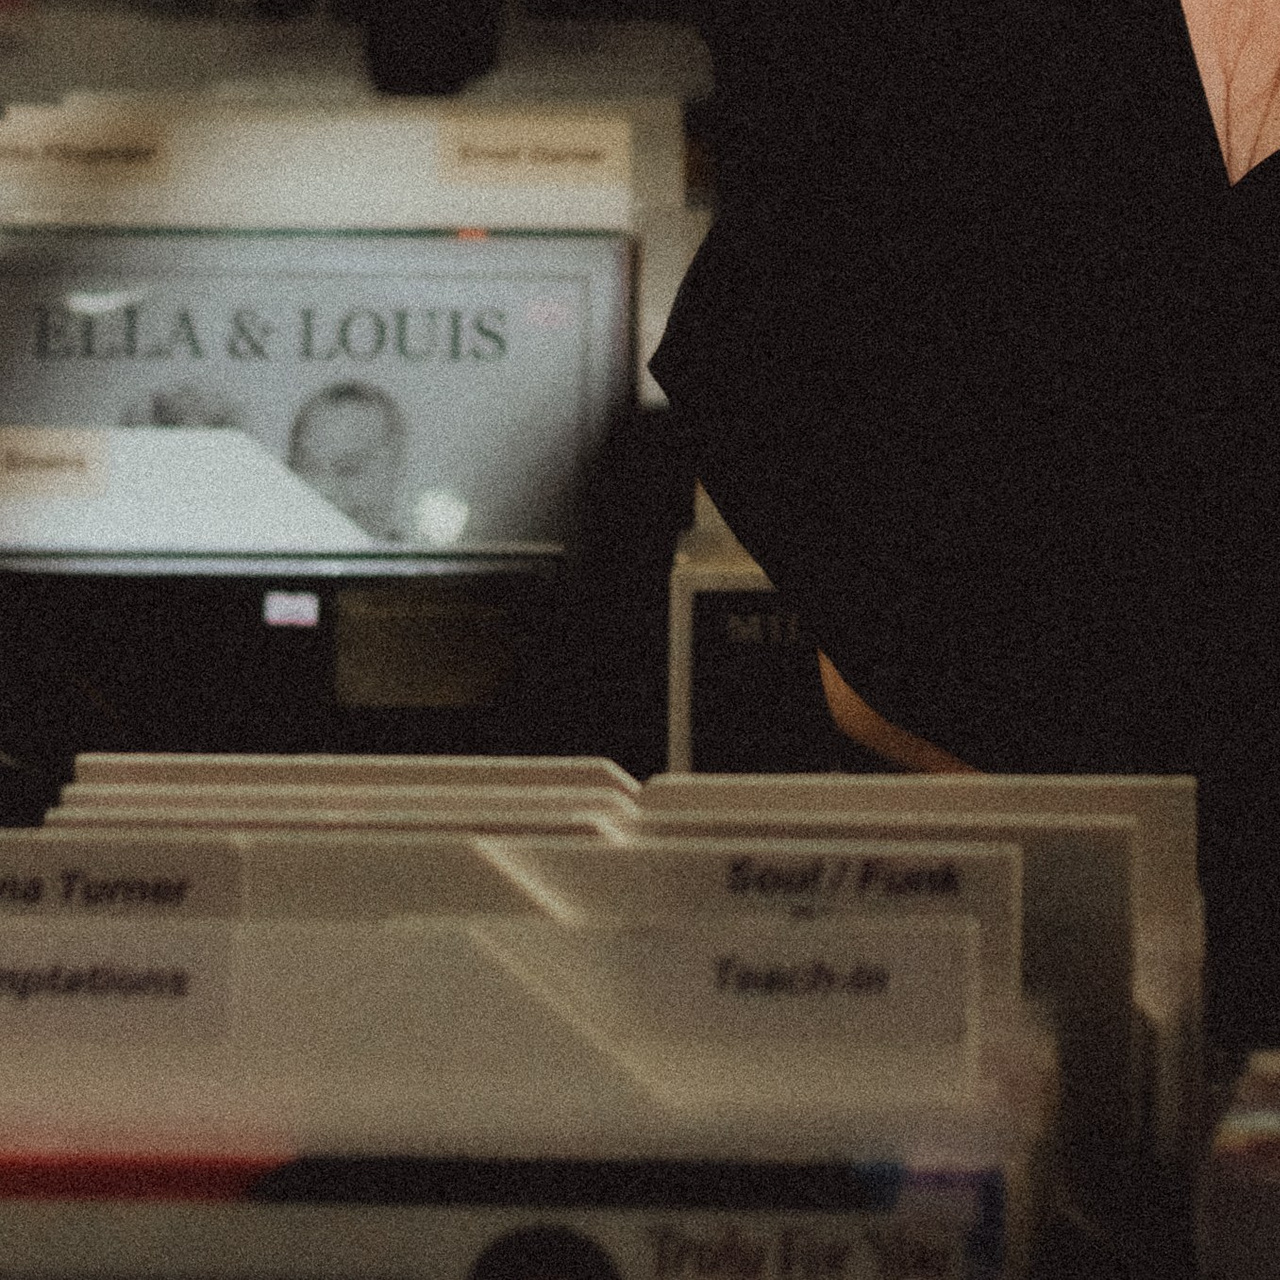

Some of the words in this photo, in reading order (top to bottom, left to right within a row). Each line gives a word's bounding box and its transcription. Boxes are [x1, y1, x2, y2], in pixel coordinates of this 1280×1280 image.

[35, 304, 203, 361] ELLA
[228, 306, 275, 361] &
[298, 305, 508, 362] LOUIS
[60, 868, 191, 905] Turner
